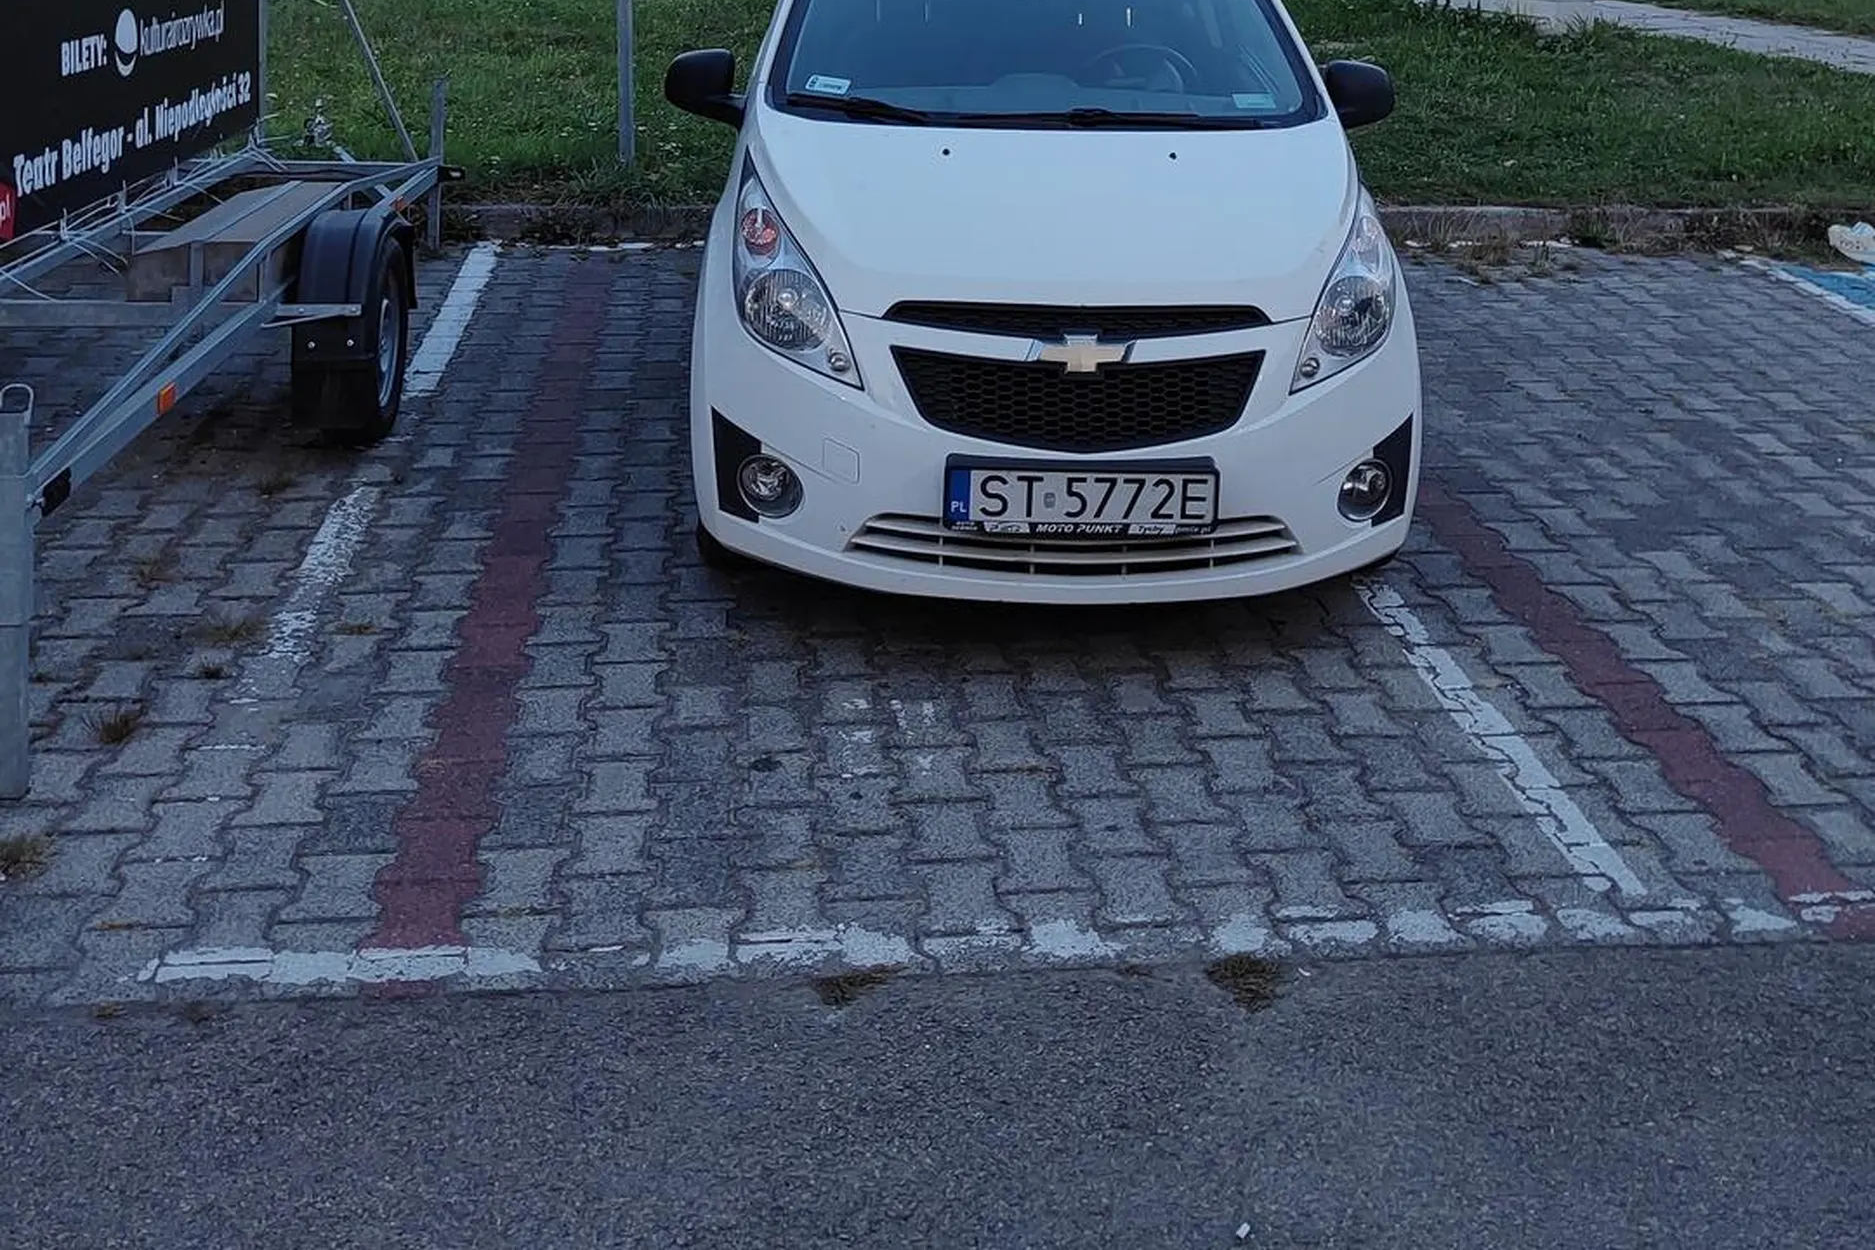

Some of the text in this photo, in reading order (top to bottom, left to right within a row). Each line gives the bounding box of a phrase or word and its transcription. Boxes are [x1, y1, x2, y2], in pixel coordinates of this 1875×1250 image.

[61, 33, 108, 78] BILETY:
[13, 146, 58, 198] Teatr
[62, 126, 125, 180] Belfegor
[237, 70, 251, 105] 32
[951, 501, 967, 513] PL
[979, 475, 1209, 519] ST 5772E
[1035, 523, 1124, 534] MOTO PUNKT
